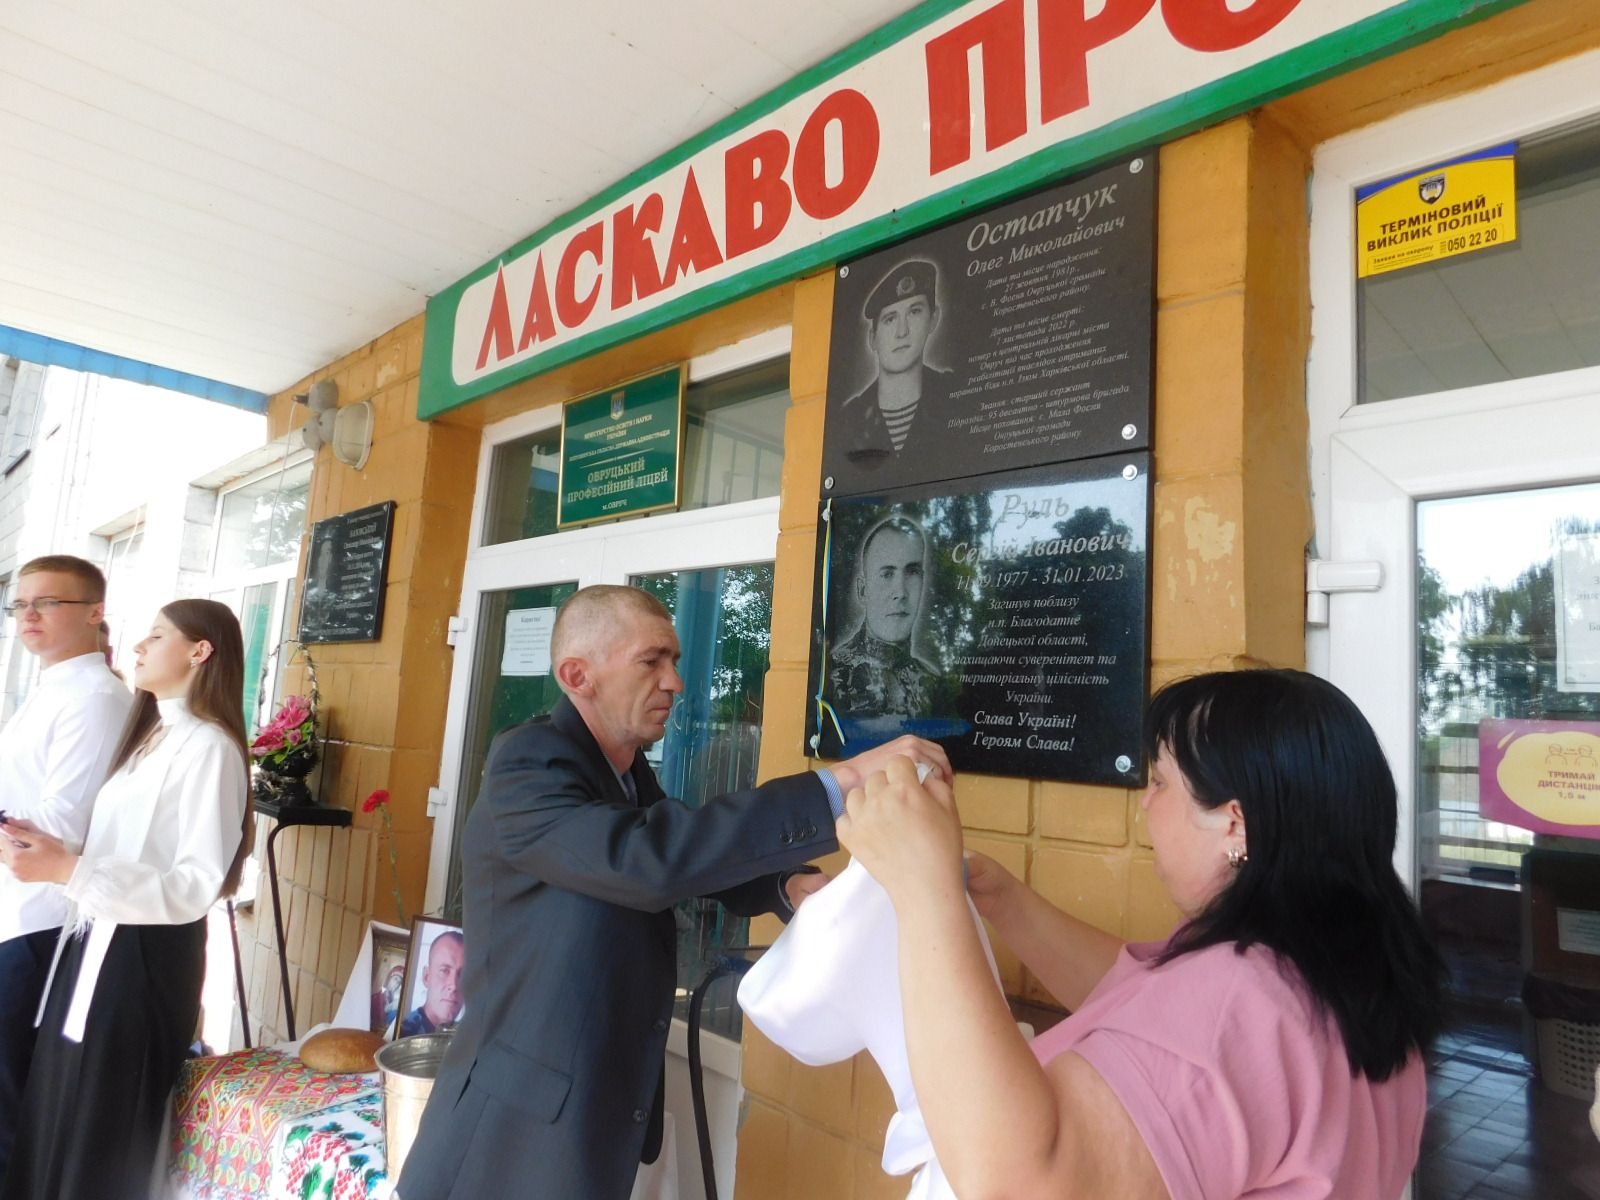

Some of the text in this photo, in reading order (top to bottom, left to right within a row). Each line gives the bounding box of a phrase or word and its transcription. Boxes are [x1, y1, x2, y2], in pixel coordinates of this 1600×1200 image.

[966, 183, 1118, 252] Остапчук
[1379, 194, 1487, 236] ТЕРМІНОВИЙ
[474, 88, 880, 372] ЛАСКАВО
[1367, 225, 1433, 252] ВИКЛИК
[1437, 202, 1504, 234] ПОЛІЦІЇ
[967, 216, 1125, 277] Олег Миколайович
[1447, 236, 1466, 253] 050
[1469, 231, 1482, 246] 22
[1485, 228, 1498, 243] 20
[985, 277, 1008, 289] Дата
[1092, 384, 1130, 402] бригада
[587, 457, 646, 484] ОВРУЦЬКИЙ
[567, 467, 669, 504] ПРОФЕСІЙНИЙ ЛІЦЕЙ
[1024, 531, 1132, 558] Іванович
[1041, 564, 1125, 586] 31.01.2023
[988, 595, 1080, 613] Загинув поблизу
[988, 613, 1081, 628] н.п. Благодатне
[977, 633, 1089, 649] Донецької області,
[1018, 653, 1094, 669] суверенітет
[1097, 655, 1117, 666] та
[959, 673, 1110, 687] територіальну цілісність
[974, 710, 1077, 731] Слава Україні!
[972, 731, 1076, 752] Героям Слава!
[1547, 770, 1596, 781] ТРИМАЙ
